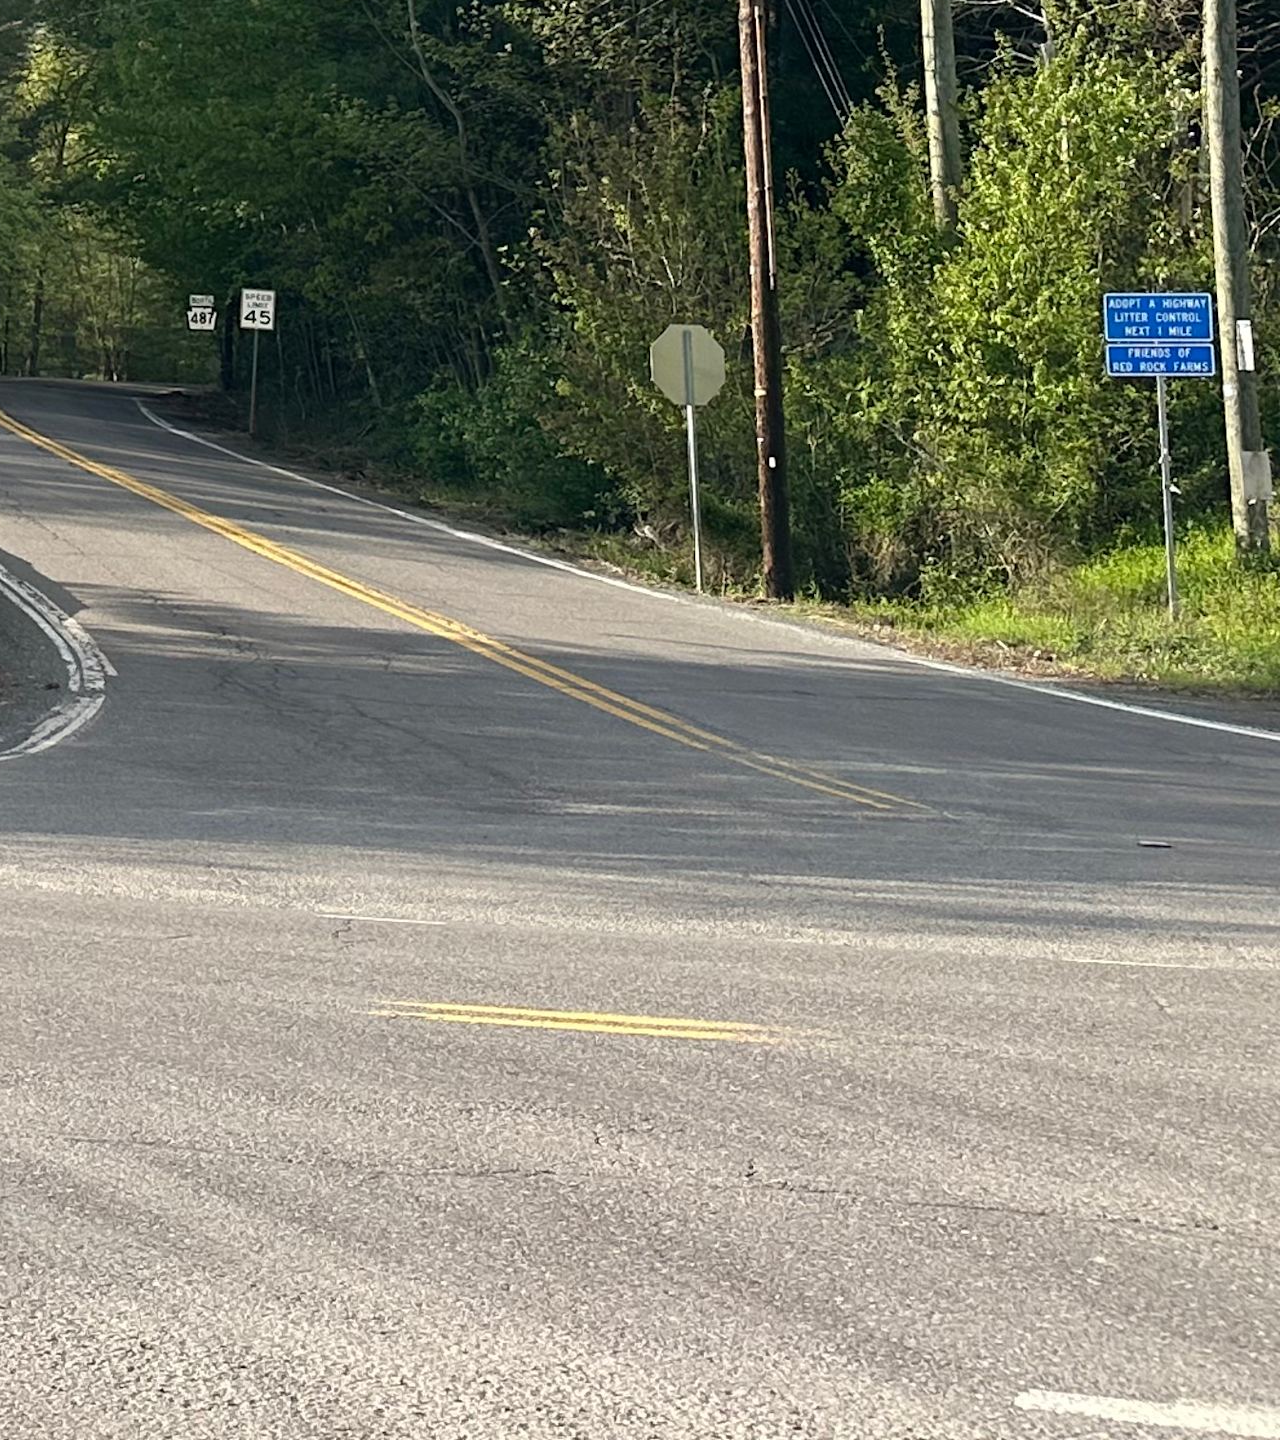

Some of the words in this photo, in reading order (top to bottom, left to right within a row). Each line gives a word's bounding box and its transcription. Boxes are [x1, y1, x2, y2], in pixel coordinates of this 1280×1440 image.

[245, 293, 272, 301] SPEED
[1109, 299, 1141, 309] ADOPT
[1149, 299, 1156, 309] A
[1162, 299, 1206, 309] HIGHWAY
[191, 312, 214, 324] 487
[244, 310, 271, 324] 45
[1114, 313, 1148, 322] LITTER
[1156, 313, 1202, 322] CONTROL
[1125, 326, 1150, 336] NEXT
[1169, 326, 1192, 336] MILE
[1127, 348, 1171, 358] FRIENDS
[1178, 348, 1191, 358] OF
[1112, 362, 1133, 372] RED
[1140, 362, 1166, 372] ROCK
[1173, 362, 1209, 372] FARMS
